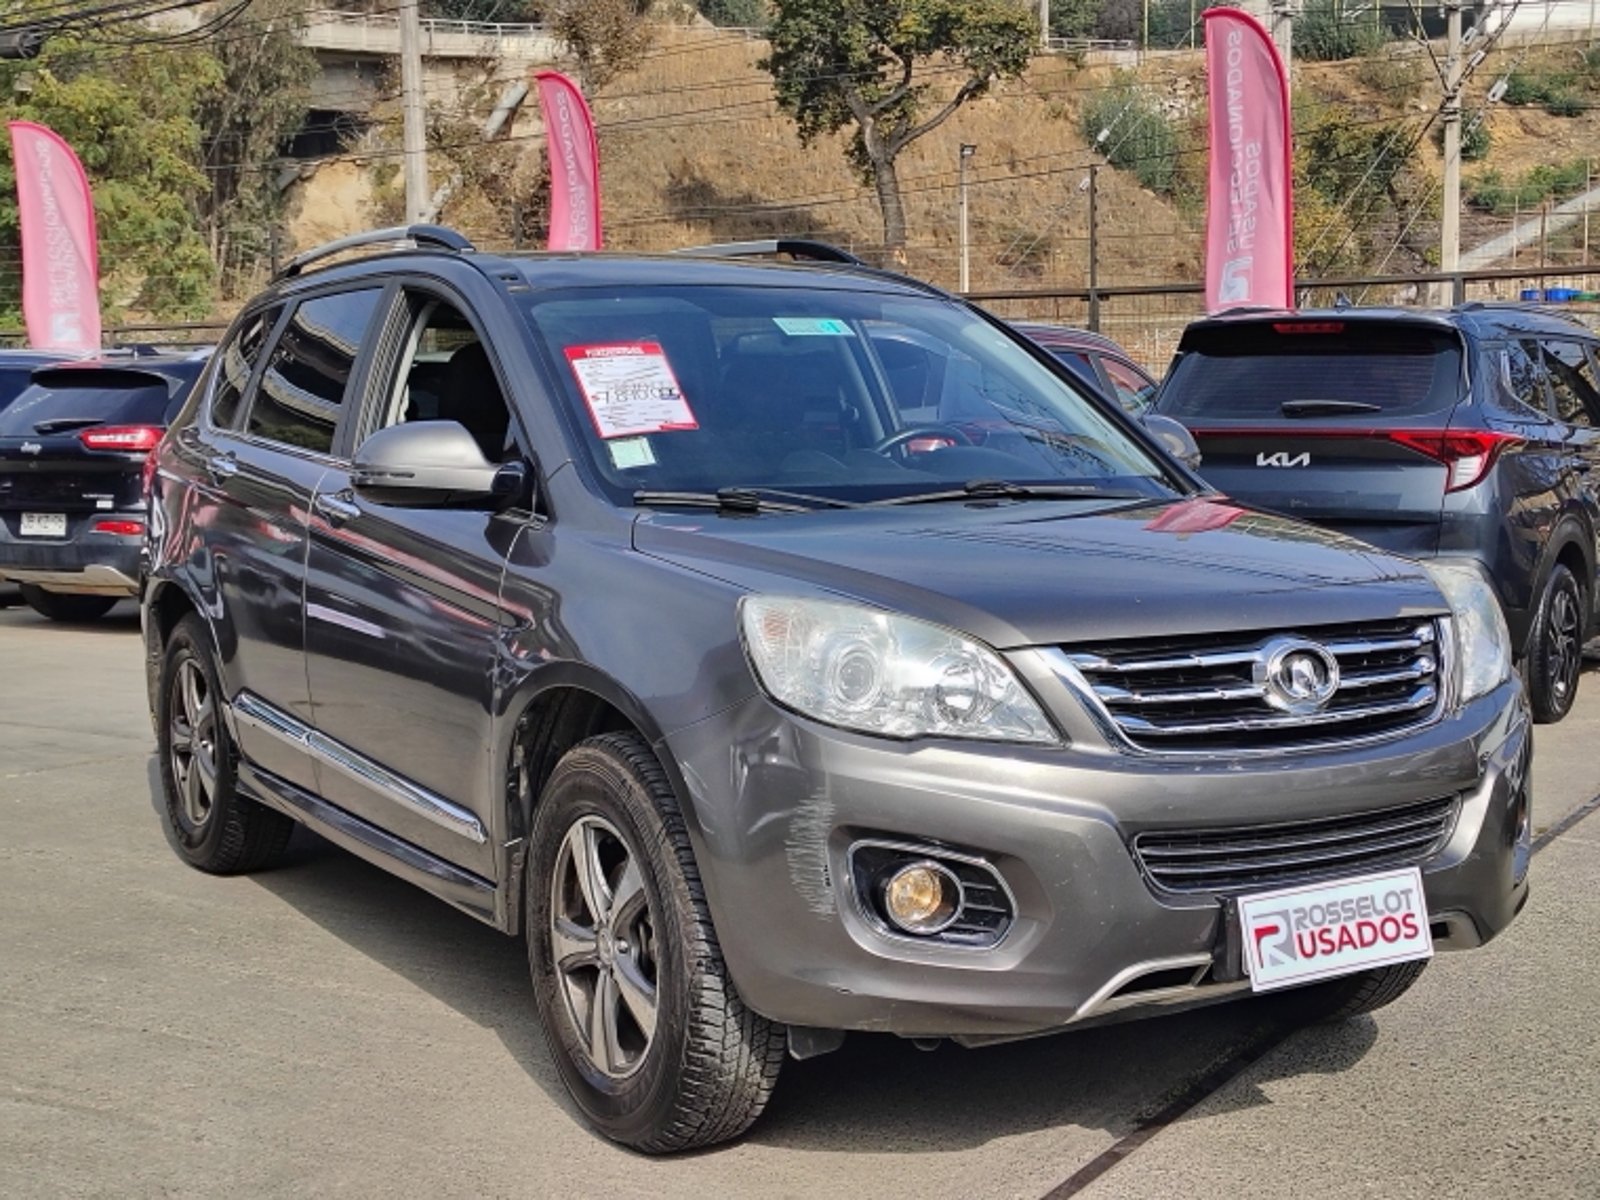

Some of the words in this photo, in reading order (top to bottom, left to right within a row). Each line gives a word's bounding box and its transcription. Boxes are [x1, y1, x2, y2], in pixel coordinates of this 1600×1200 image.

[1256, 451, 1311, 467] KIA
[1293, 888, 1413, 931] ROSSELOT
[1296, 913, 1419, 959] USADOS
